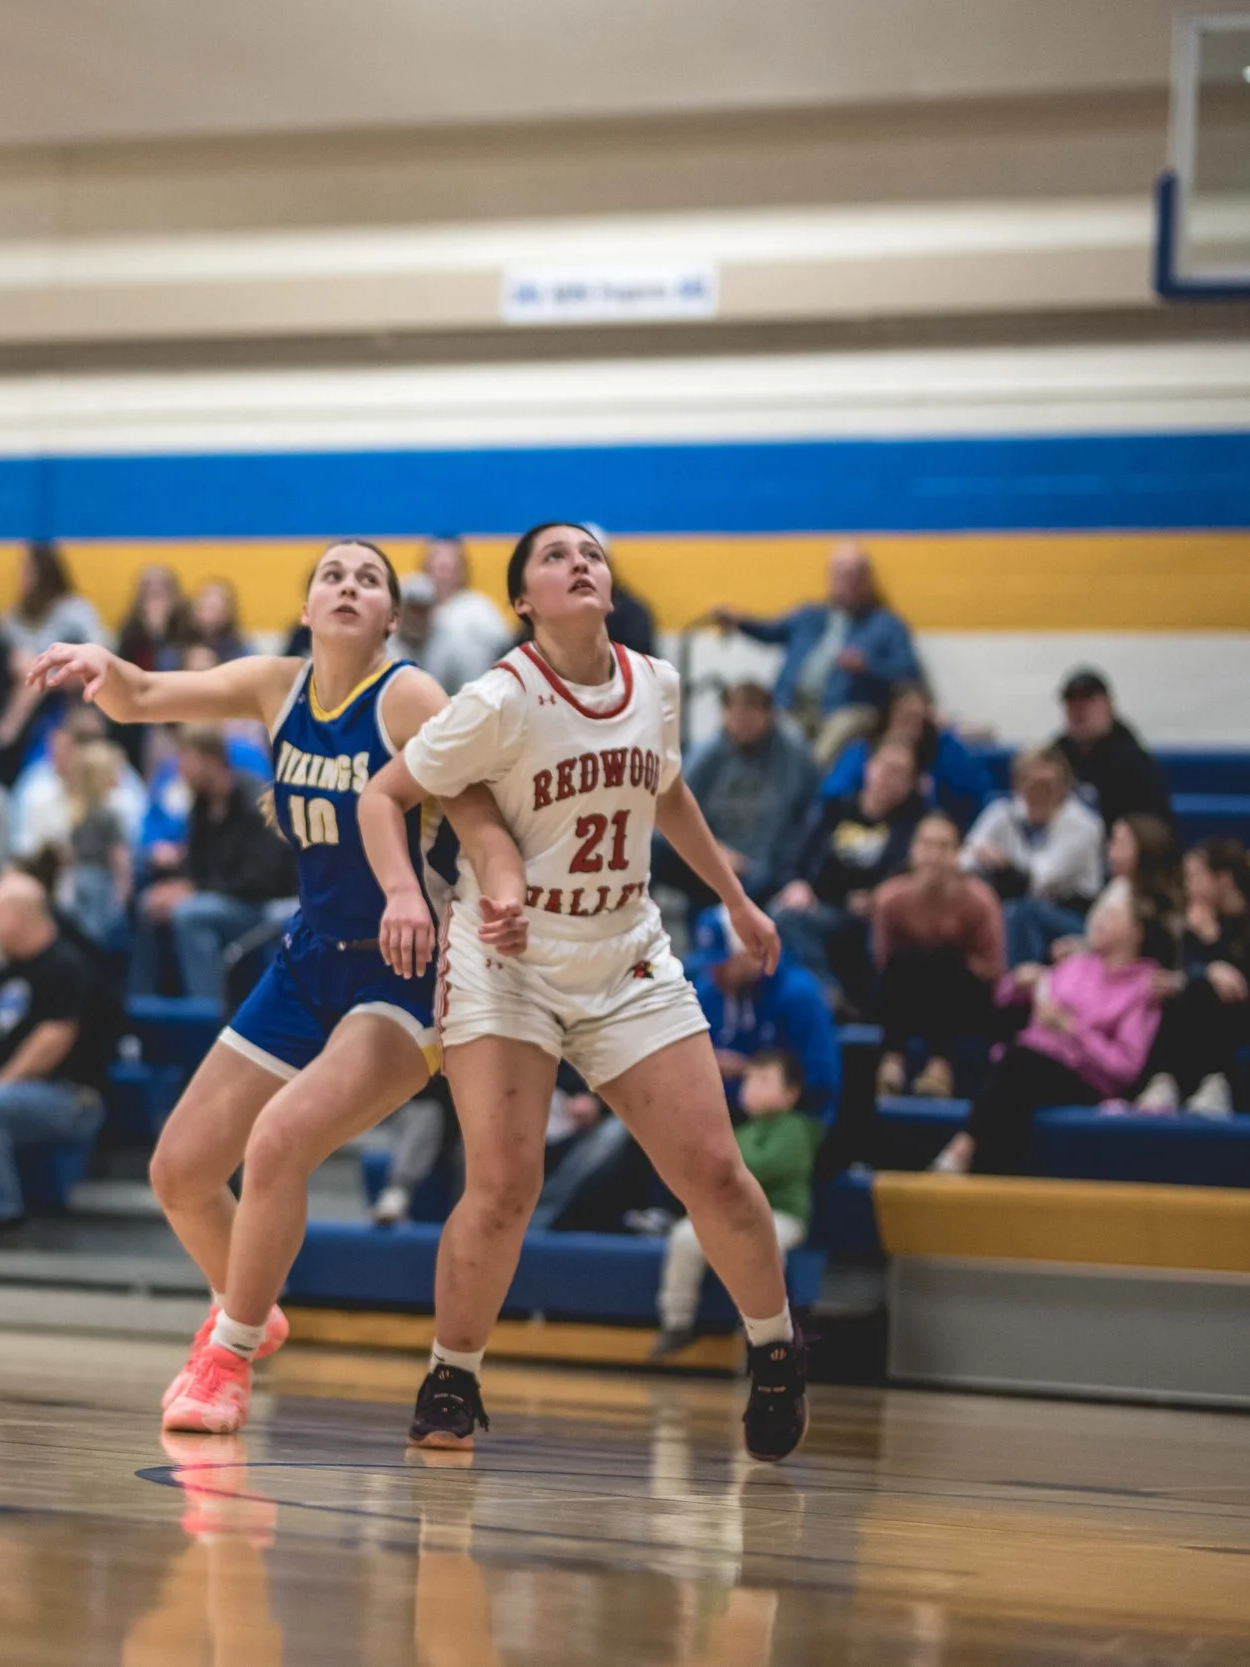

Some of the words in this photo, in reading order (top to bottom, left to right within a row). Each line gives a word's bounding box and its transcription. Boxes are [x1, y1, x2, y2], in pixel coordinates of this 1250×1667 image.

[276, 740, 370, 795] VIKINGS
[289, 794, 339, 849] 10
[568, 808, 631, 874] 21
